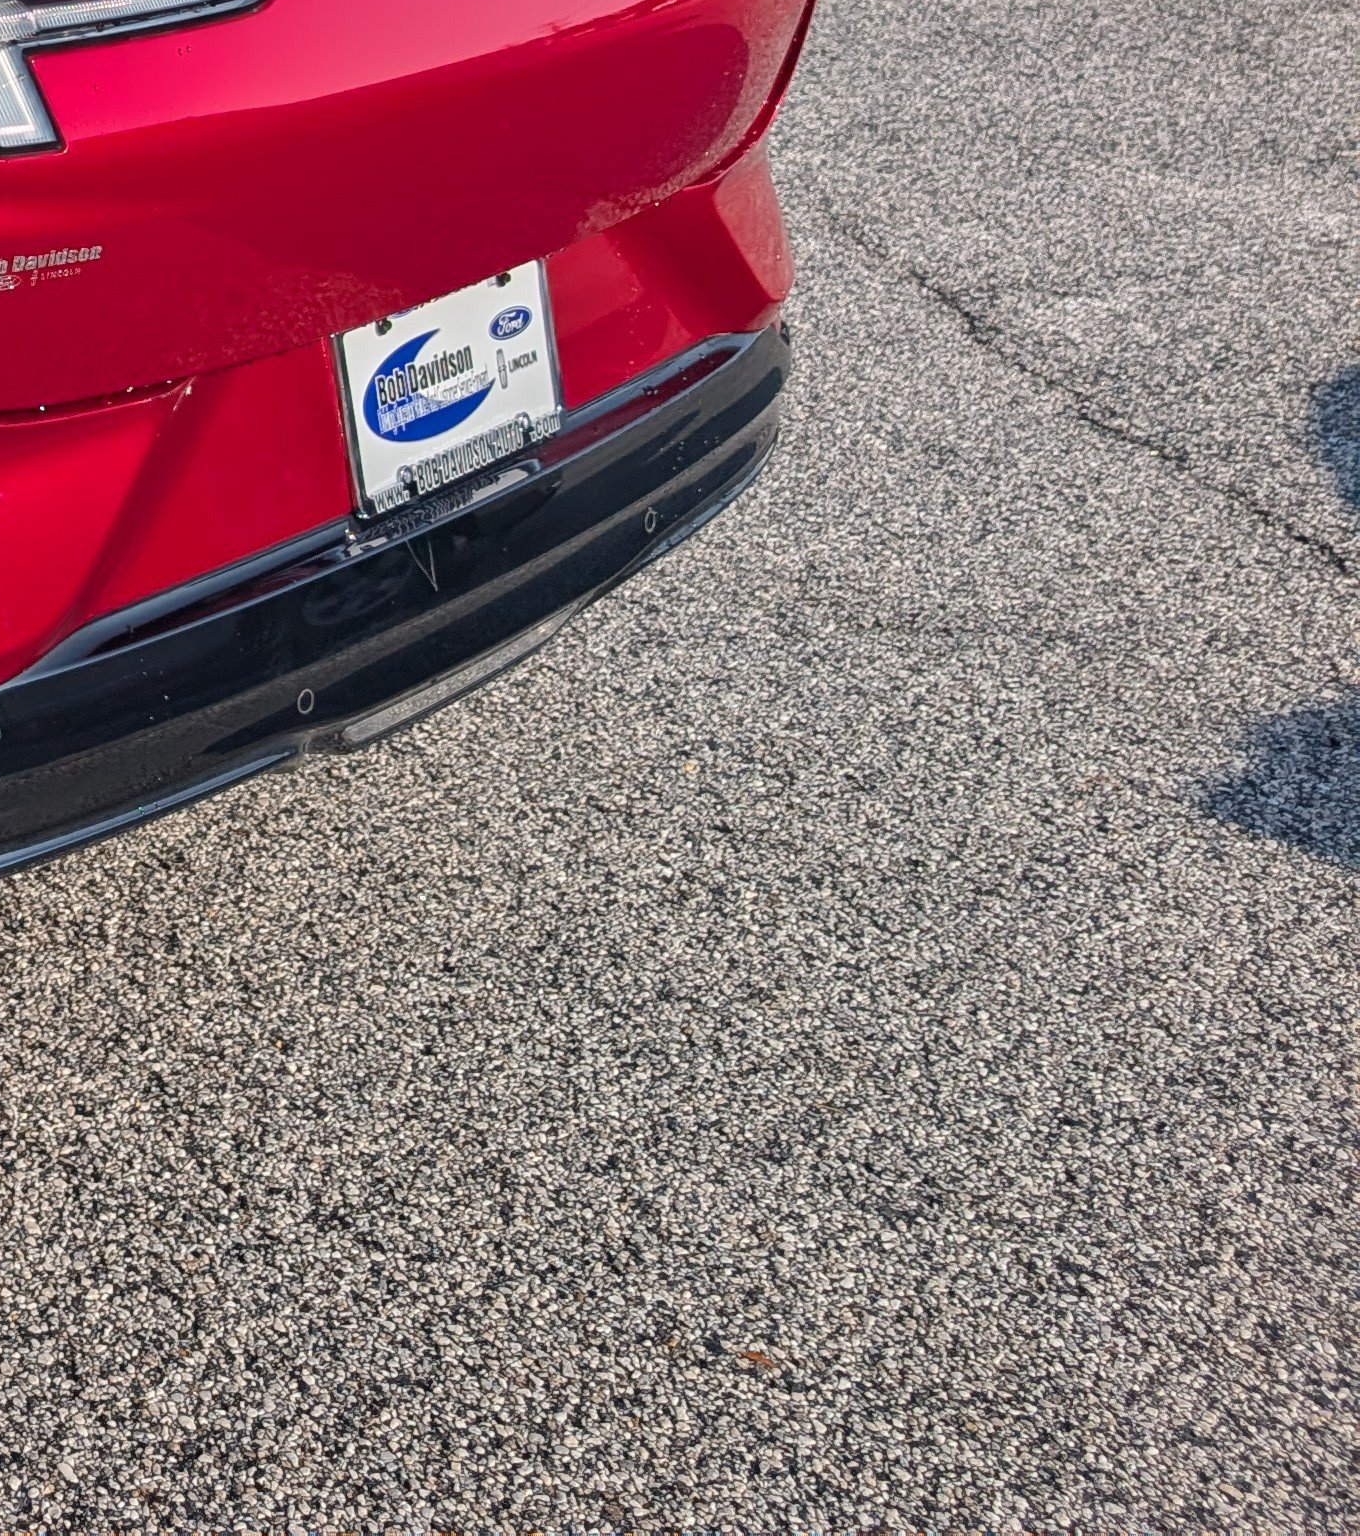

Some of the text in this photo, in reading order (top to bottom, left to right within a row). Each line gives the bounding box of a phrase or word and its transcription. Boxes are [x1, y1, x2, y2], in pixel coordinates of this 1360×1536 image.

[11, 245, 103, 273] Davidson
[376, 370, 406, 406] Bob
[406, 345, 474, 394] Davidson
[507, 349, 538, 374] LINCOLN
